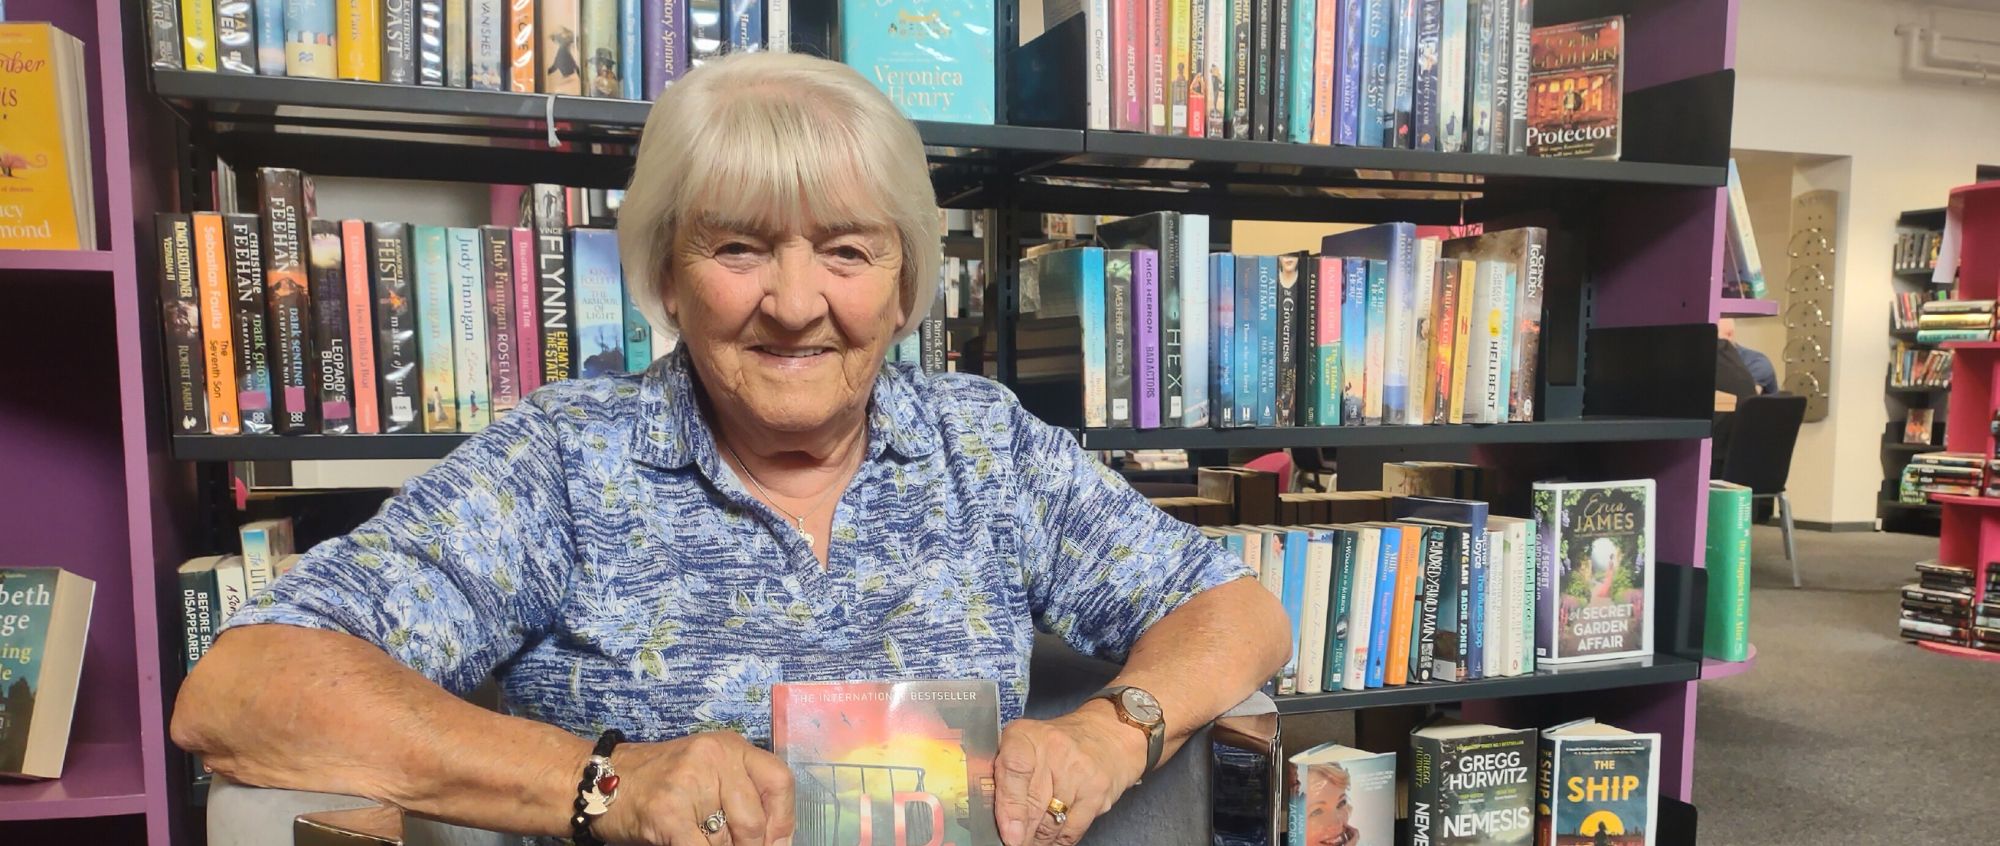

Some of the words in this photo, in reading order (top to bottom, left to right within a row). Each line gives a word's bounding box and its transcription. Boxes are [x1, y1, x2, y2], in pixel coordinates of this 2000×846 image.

[481, 2, 492, 57] VANISHES
[662, 30, 677, 76] Spinner
[1154, 54, 1162, 74] HIT
[874, 65, 963, 86] Veronica
[1154, 77, 1162, 100] LIST
[1398, 49, 1409, 97] HARRIS
[1496, 66, 1508, 107] DARK
[1513, 34, 1530, 120] HENDERSON
[889, 86, 955, 111] Henry
[1367, 84, 1378, 110] SPY
[1376, 63, 1386, 125] OFFICER
[1526, 124, 1615, 147] Protector
[271, 196, 289, 276] FEEHAN
[204, 226, 218, 287] Sebastian
[233, 223, 253, 302] FEEHAN
[377, 238, 397, 284] FEIST
[456, 236, 474, 271] Judy
[490, 237, 508, 269] Judy
[176, 248, 192, 298] EXECUTIONER
[539, 234, 567, 328] FLYNN
[1527, 244, 1542, 298] IGGULDEN
[1537, 255, 1545, 289] CONN
[208, 290, 221, 329] Faulks
[459, 275, 476, 342] Finnigan
[492, 271, 509, 330] Finnigan
[522, 311, 531, 328] TIDE
[1282, 297, 1294, 363] Governess
[220, 340, 228, 356] The
[546, 332, 558, 349] THE
[557, 331, 568, 368] ENEMY
[926, 341, 932, 351] an
[1145, 346, 1154, 363] BAD
[178, 345, 191, 378] ROBERT
[210, 340, 220, 378] Seventh
[321, 351, 335, 391] BLOOD
[331, 339, 346, 402] LEOPARD'S
[496, 333, 511, 403] ROSELAND
[545, 350, 560, 382] STATE
[1166, 328, 1182, 390] HEX
[1262, 358, 1267, 369] WE
[212, 380, 222, 398] Son
[360, 369, 370, 389] Boat
[1146, 364, 1155, 398] ACTORS
[1487, 341, 1498, 411] HELLBENT
[1583, 493, 1626, 518] Erica
[1574, 512, 1634, 533] JAMES
[1382, 544, 1391, 582] Johnson
[1388, 551, 1398, 573] Milly
[1461, 532, 1470, 585] AMY&LAN
[1474, 536, 1484, 570] Joyce
[226, 585, 238, 593] A
[1736, 557, 1746, 596] Happiest
[198, 592, 210, 633] BEFORE
[226, 595, 240, 617] Song
[1524, 589, 1534, 623] Joyce
[1583, 603, 1634, 620] SECRET
[1736, 598, 1744, 617] Ever
[184, 589, 199, 660] DISAPPEARED
[1422, 614, 1435, 642] MAN
[1460, 623, 1468, 655] JONES
[1475, 624, 1483, 648] Shop
[1573, 620, 1628, 637] GARDEN
[1735, 621, 1744, 641] After
[200, 635, 210, 655] SHE
[1577, 635, 1623, 651] AFFAIR
[794, 694, 814, 704] THE
[818, 691, 905, 702] INTERNATION
[911, 691, 976, 700] BESTSELLER
[1415, 745, 1424, 788] HURWITZ
[1423, 753, 1431, 784] GREGG
[1450, 766, 1528, 790] HURWITZ
[1458, 751, 1520, 773] GREGG
[1594, 760, 1616, 770] THE
[1540, 760, 1551, 799] SHIP
[1567, 775, 1640, 803] SHIP
[1288, 803, 1297, 844] JACOBS
[1442, 806, 1530, 838] NEMESIS
